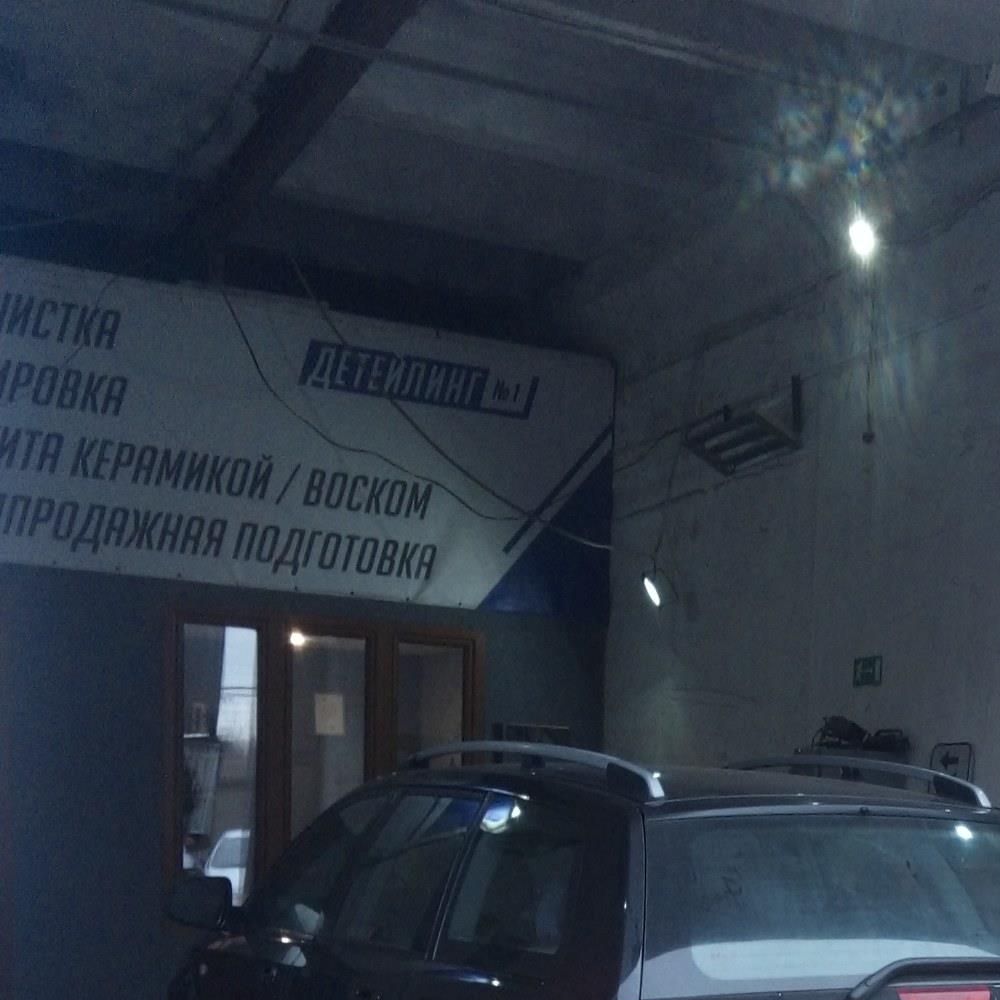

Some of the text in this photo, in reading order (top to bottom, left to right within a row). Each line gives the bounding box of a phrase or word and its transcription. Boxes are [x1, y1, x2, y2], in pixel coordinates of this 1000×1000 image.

[306, 346, 483, 405] ДЕТЕЙЛИНГ
[70, 436, 276, 500] КЕРАМИКОЙ
[303, 467, 434, 520] ВОСКОМ
[0, 493, 438, 581] ПРОДАЖНАЯ ПОДГОТОВКА
